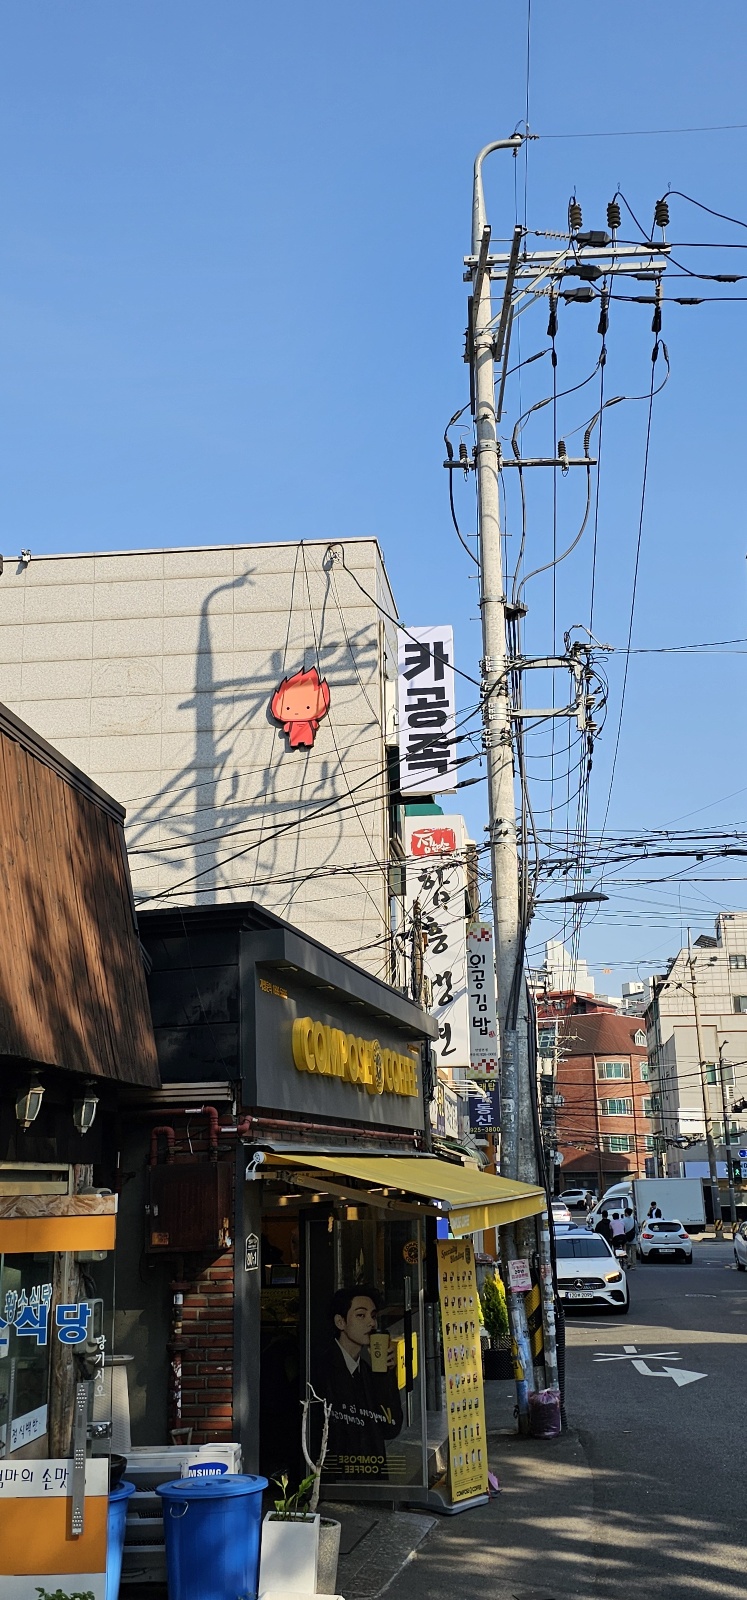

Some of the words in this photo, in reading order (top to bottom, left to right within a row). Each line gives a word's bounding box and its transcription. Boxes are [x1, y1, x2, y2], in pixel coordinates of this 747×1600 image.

[402, 641, 451, 774] 카공족
[292, 1016, 373, 1085] COMPOSE
[382, 1047, 419, 1098] COFFEE
[0, 1302, 92, 1346] 식당
[4, 1283, 54, 1325] 황소식당
[94, 1334, 107, 1397] 당기시오
[188, 1468, 222, 1478] MSUNG
